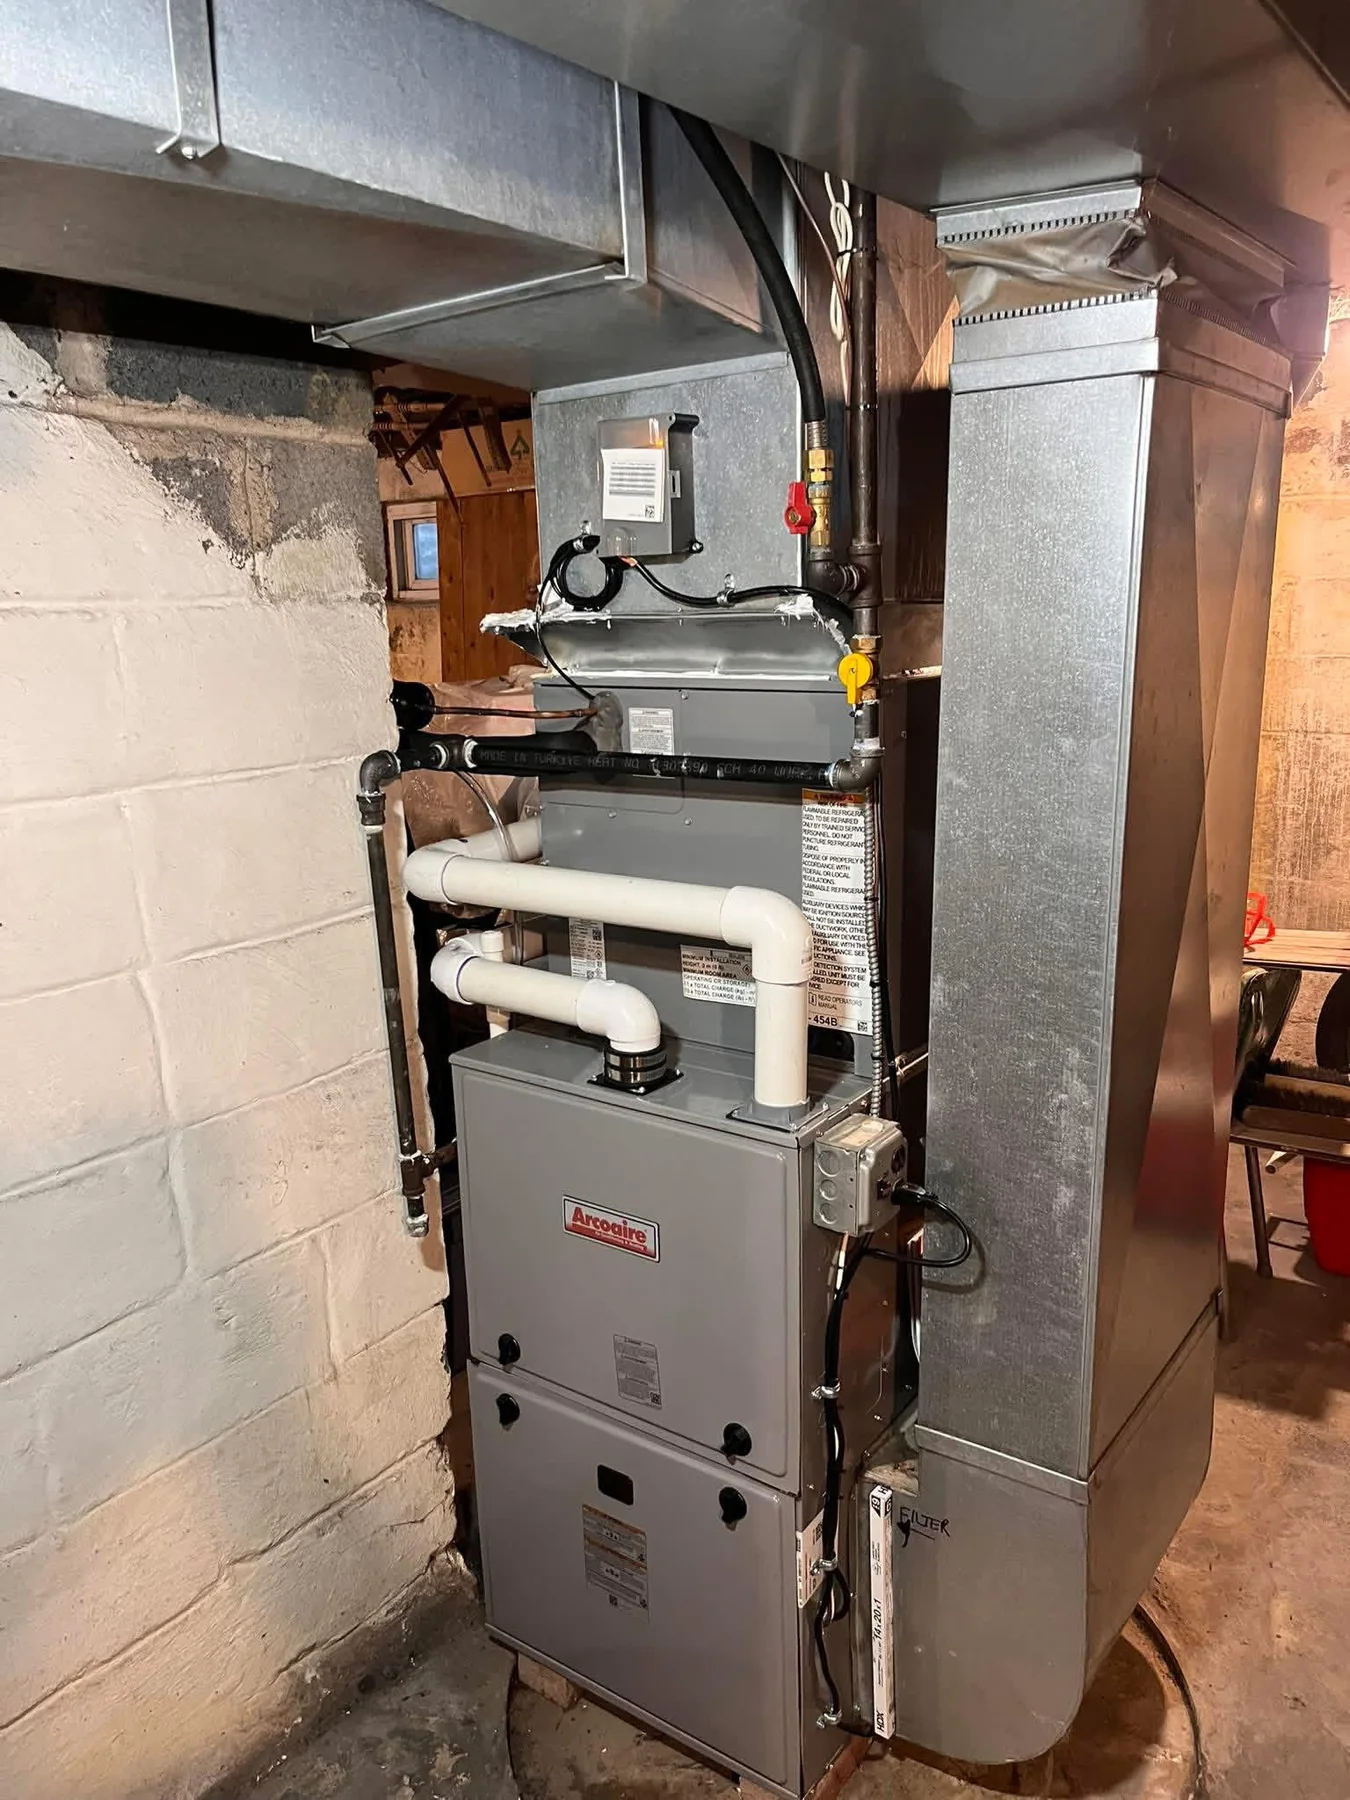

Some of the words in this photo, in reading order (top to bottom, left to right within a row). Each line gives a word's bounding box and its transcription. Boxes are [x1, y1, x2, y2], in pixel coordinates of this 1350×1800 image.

[829, 856, 860, 864] PROPERLY
[825, 902, 850, 910] DEVICES
[843, 965, 867, 973] SYSTEM
[813, 1014, 838, 1026] 454B
[572, 1206, 647, 1244] Arcoaire
[900, 1506, 951, 1538] FILTER
[876, 1710, 885, 1733] HDX
